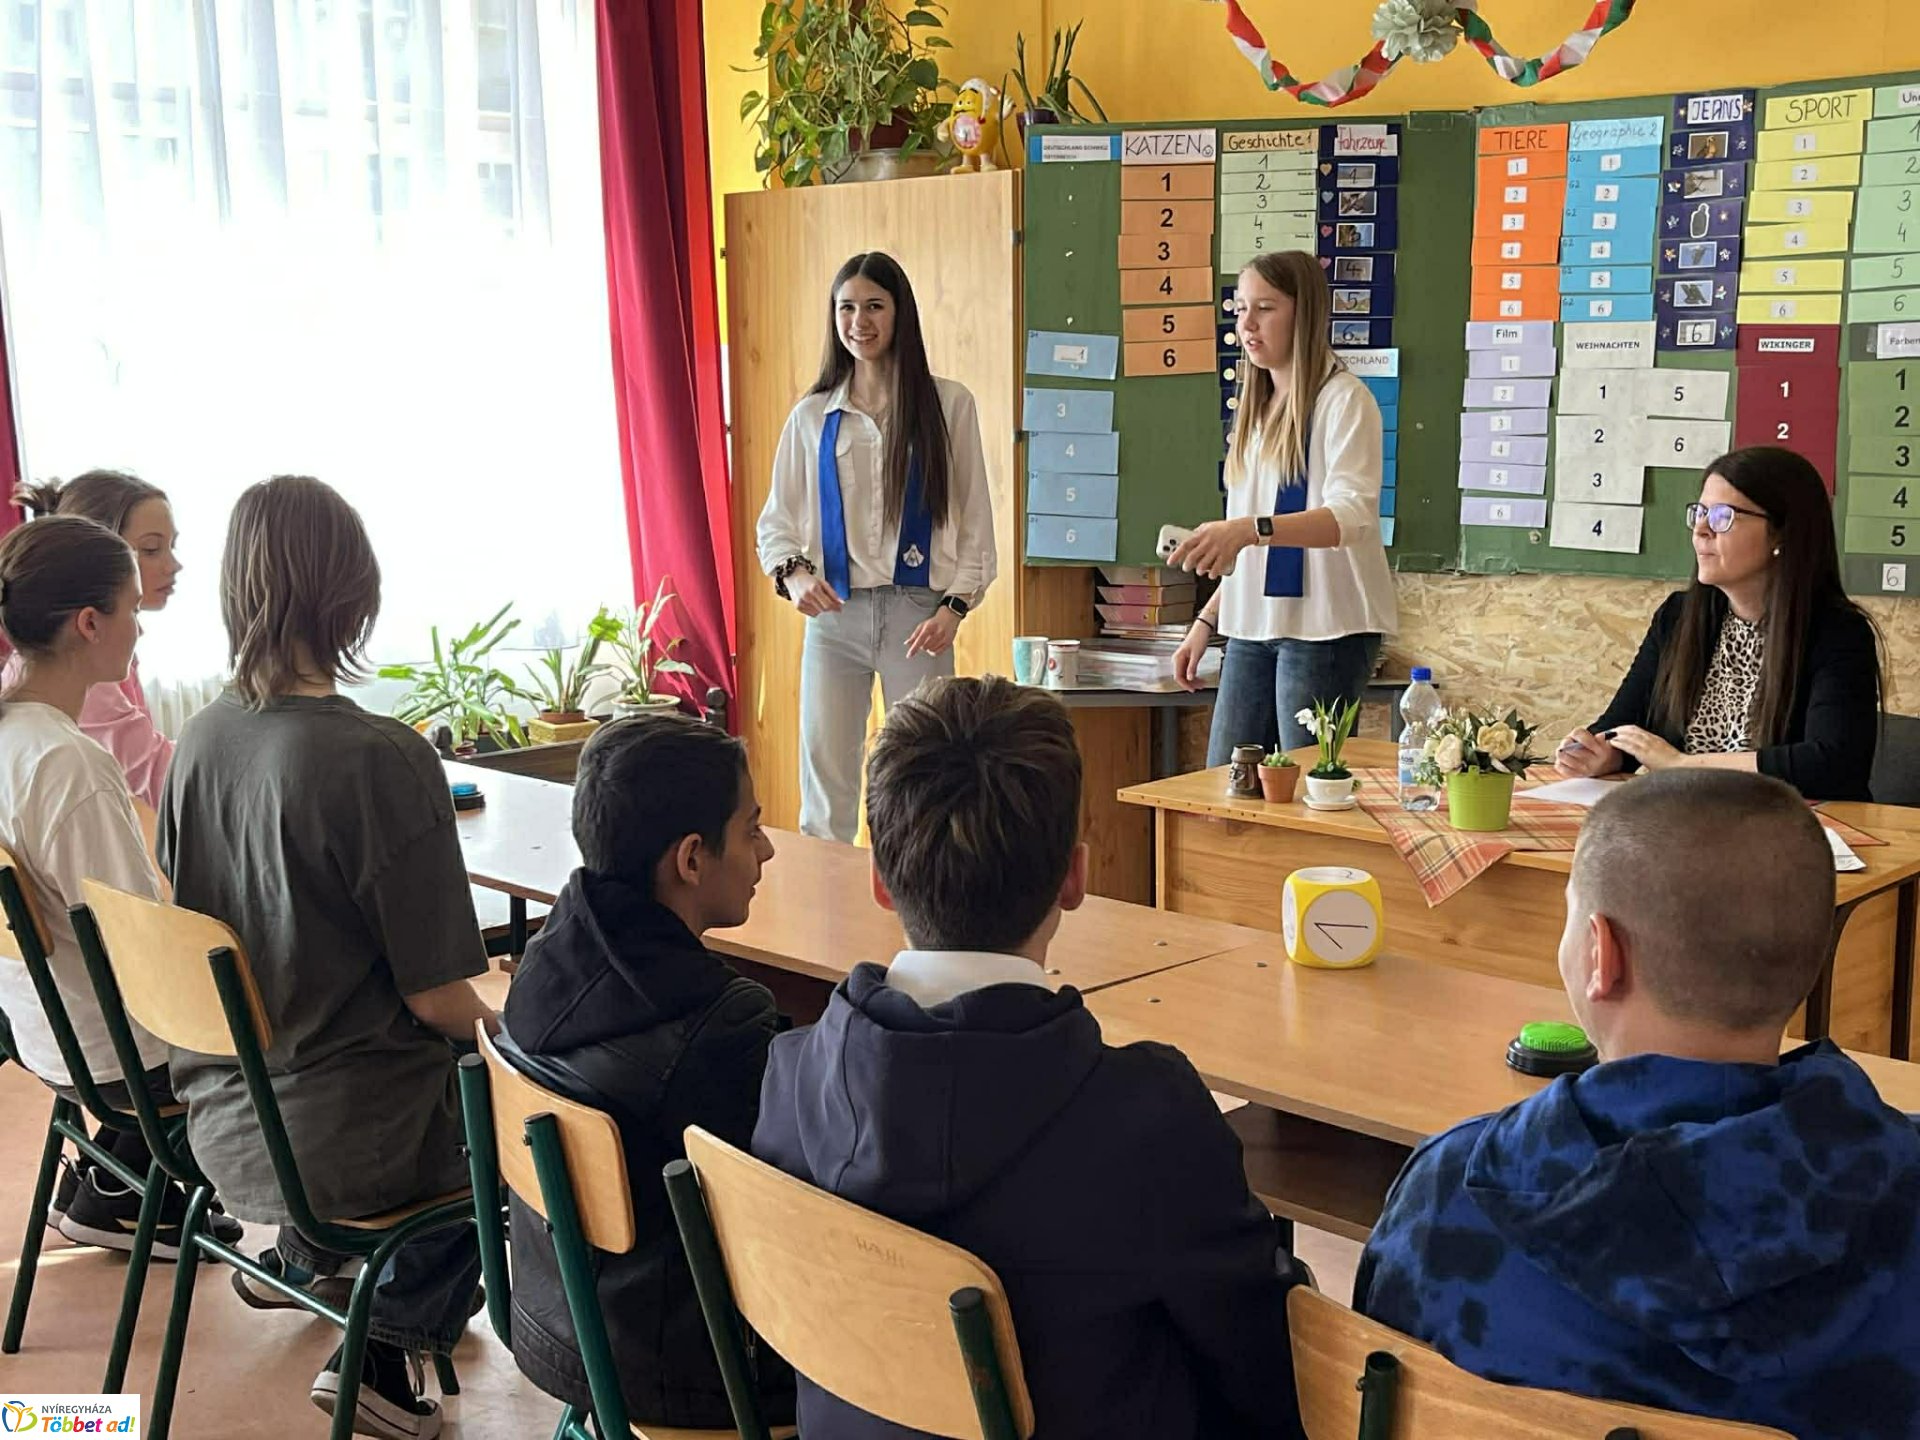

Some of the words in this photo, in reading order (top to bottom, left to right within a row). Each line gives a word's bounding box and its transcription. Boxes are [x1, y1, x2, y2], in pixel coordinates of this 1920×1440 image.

[1692, 98, 1741, 121] JEANS
[1785, 94, 1858, 123] SPORT
[1228, 133, 1304, 151] Geschichte
[1493, 130, 1549, 150] TIERE
[1573, 122, 1645, 148] Geographie
[1649, 121, 1658, 137] 2
[1125, 134, 1202, 156] KATZEN
[1802, 138, 1807, 149] 1
[1258, 154, 1269, 170] 1
[1514, 162, 1520, 172] 1
[1608, 157, 1613, 168] 1
[1905, 156, 1920, 174] 2
[1161, 172, 1171, 192] 1
[1256, 173, 1271, 190] 2
[1800, 169, 1808, 180] 2
[1512, 190, 1519, 200] 2
[1603, 188, 1610, 198] 2
[1897, 189, 1912, 212] 3
[1256, 194, 1267, 209] 3
[1795, 202, 1802, 213] 3
[1160, 208, 1174, 228] 2
[1253, 214, 1263, 230] 4
[1509, 218, 1516, 228] 3
[1601, 216, 1608, 227] 3
[1791, 235, 1799, 246] 4
[1897, 222, 1906, 243] 4
[1255, 236, 1265, 249] 5
[1597, 245, 1604, 255] 4
[1157, 241, 1170, 261] 3
[1507, 246, 1514, 256] 4
[1891, 257, 1904, 279] 5
[1508, 276, 1515, 287] 5
[1597, 275, 1604, 285] 5
[1782, 271, 1789, 282] 5
[1159, 275, 1173, 295] 4
[1345, 291, 1360, 310] 5
[1507, 303, 1514, 314] 6
[1597, 303, 1605, 313] 6
[1893, 294, 1907, 312] 6
[1779, 304, 1786, 316] 6
[1162, 314, 1175, 334] 5
[1343, 323, 1355, 341] 6
[1495, 328, 1518, 338] Film
[1692, 323, 1702, 342] 6
[1576, 341, 1640, 350] WEIHNACHTEN
[1760, 340, 1811, 349] WIKINGER
[1163, 348, 1176, 368] 6
[1895, 368, 1906, 391] 1
[1500, 389, 1508, 399] 2
[1599, 385, 1606, 399] 1
[1673, 386, 1684, 402] 5
[1780, 381, 1789, 398] 1
[1057, 403, 1066, 418] 3
[1894, 405, 1910, 428] 2
[1594, 429, 1604, 443] 2
[1776, 422, 1789, 439] 2
[1065, 443, 1075, 457] 4
[1674, 437, 1684, 452] 6
[1895, 445, 1910, 467] 3
[1592, 473, 1602, 487] 3
[1066, 487, 1076, 502] 5
[1892, 486, 1908, 509] 4
[1591, 519, 1603, 536] 4
[1066, 529, 1076, 543] 6
[1890, 525, 1906, 547] 5
[1886, 566, 1899, 587] 6
